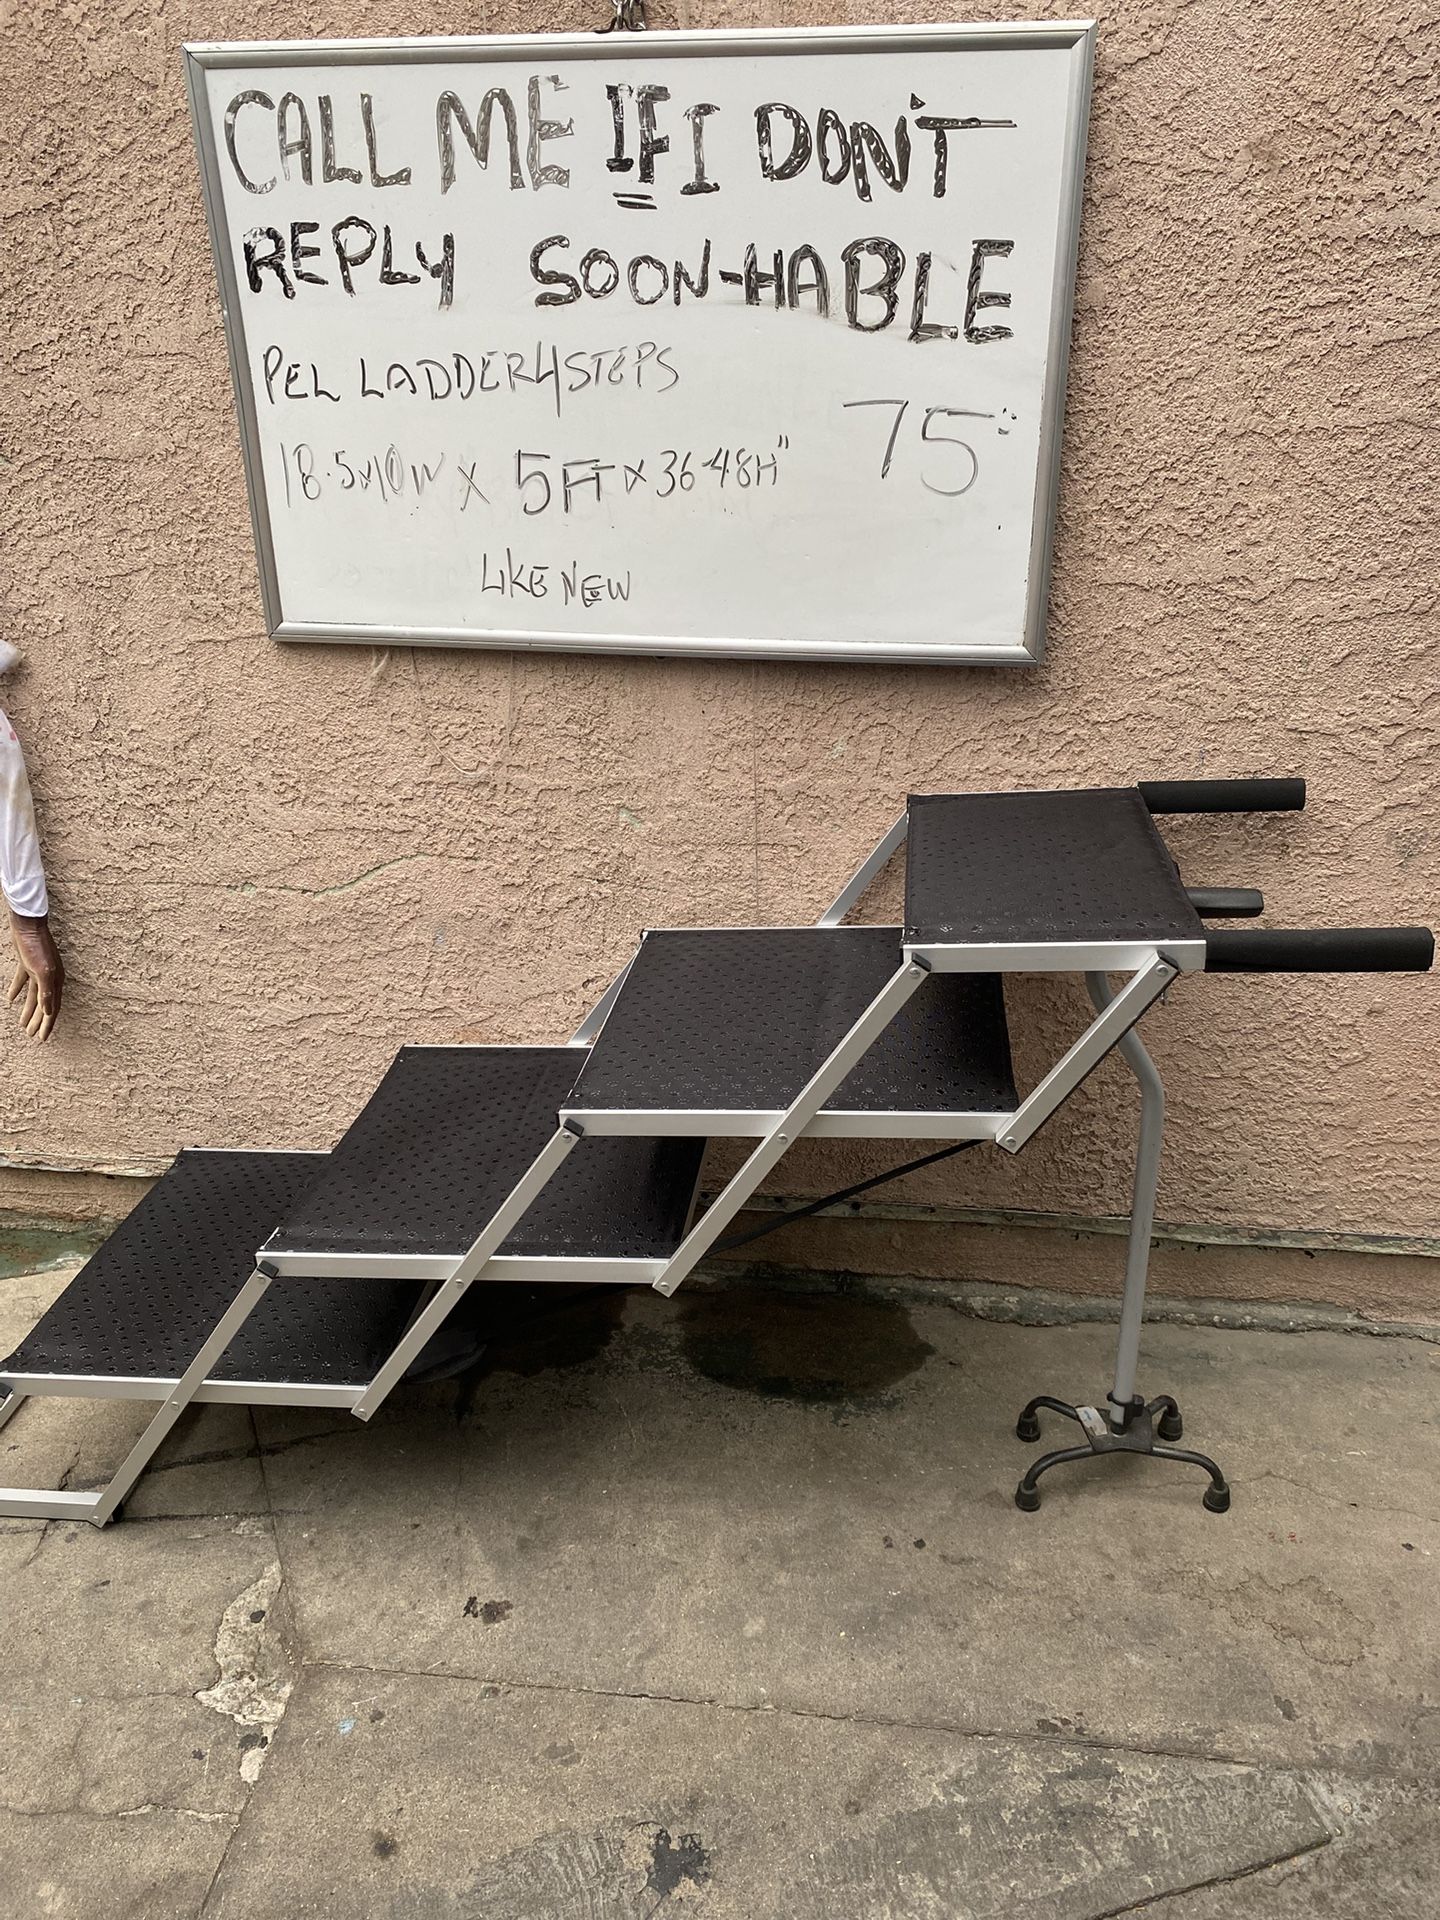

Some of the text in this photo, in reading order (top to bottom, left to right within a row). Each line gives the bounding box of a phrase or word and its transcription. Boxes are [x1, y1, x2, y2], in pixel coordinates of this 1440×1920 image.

[224, 75, 1018, 203] CALL ME IF I DON'T
[242, 215, 455, 310] REPLY
[263, 344, 340, 404] PEL
[482, 548, 631, 608] LIKE NEW
